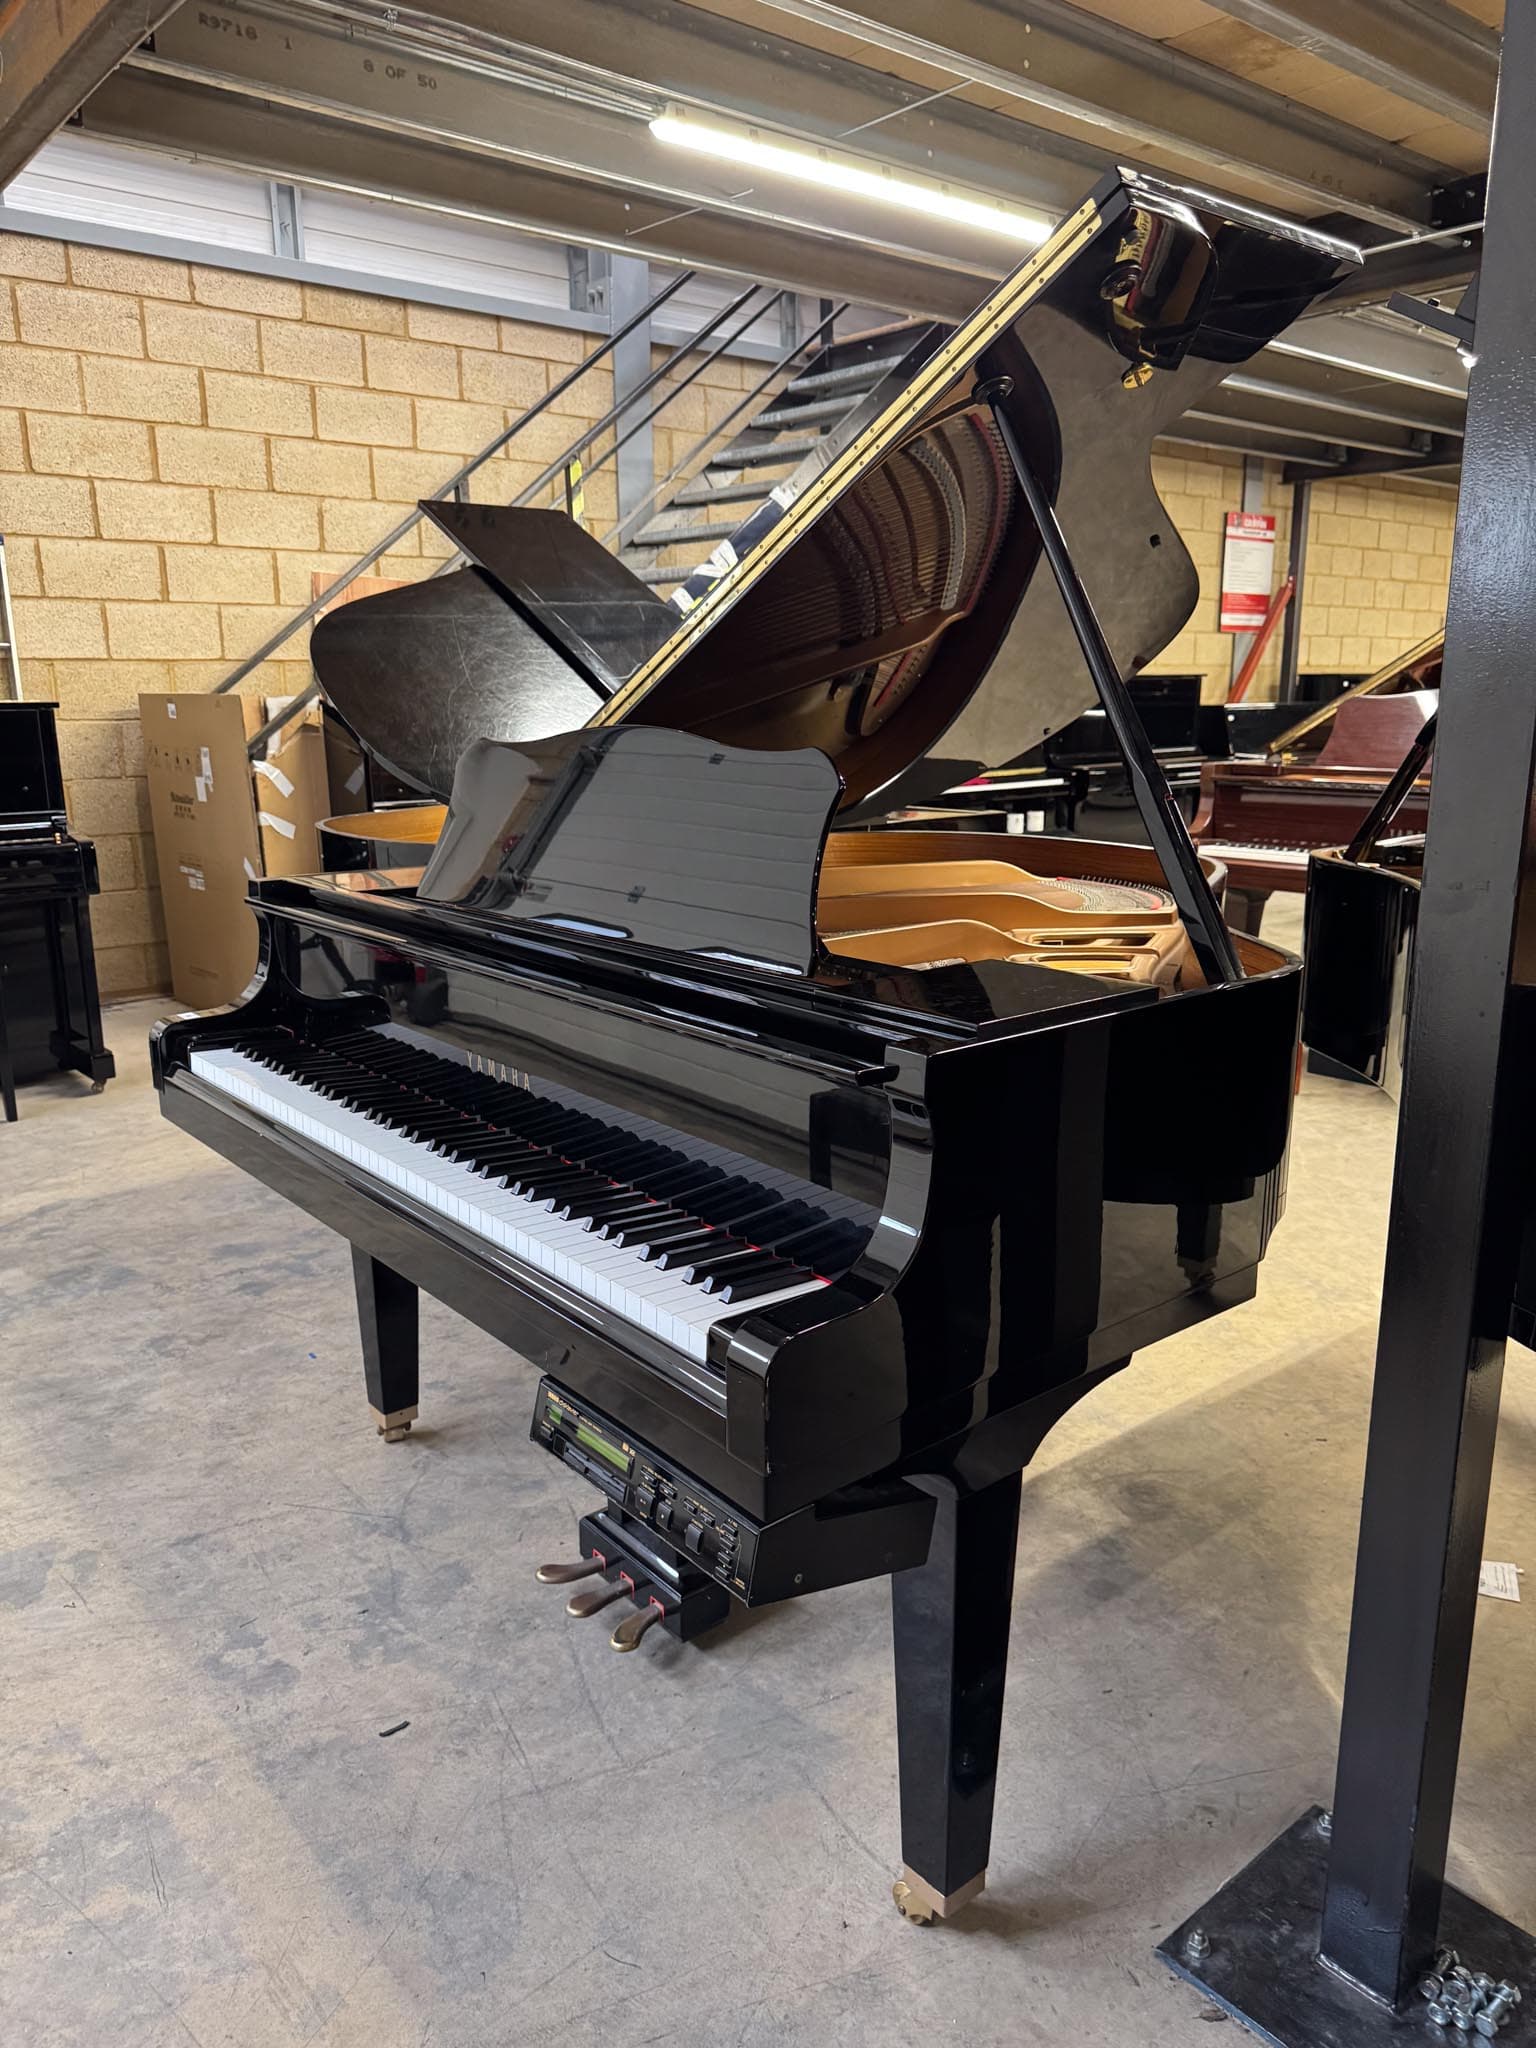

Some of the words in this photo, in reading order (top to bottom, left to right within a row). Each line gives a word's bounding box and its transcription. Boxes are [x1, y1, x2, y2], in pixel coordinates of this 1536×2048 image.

[385, 65, 406, 80] OF
[417, 73, 437, 90] 50
[466, 1050, 531, 1091] YAMAHA
